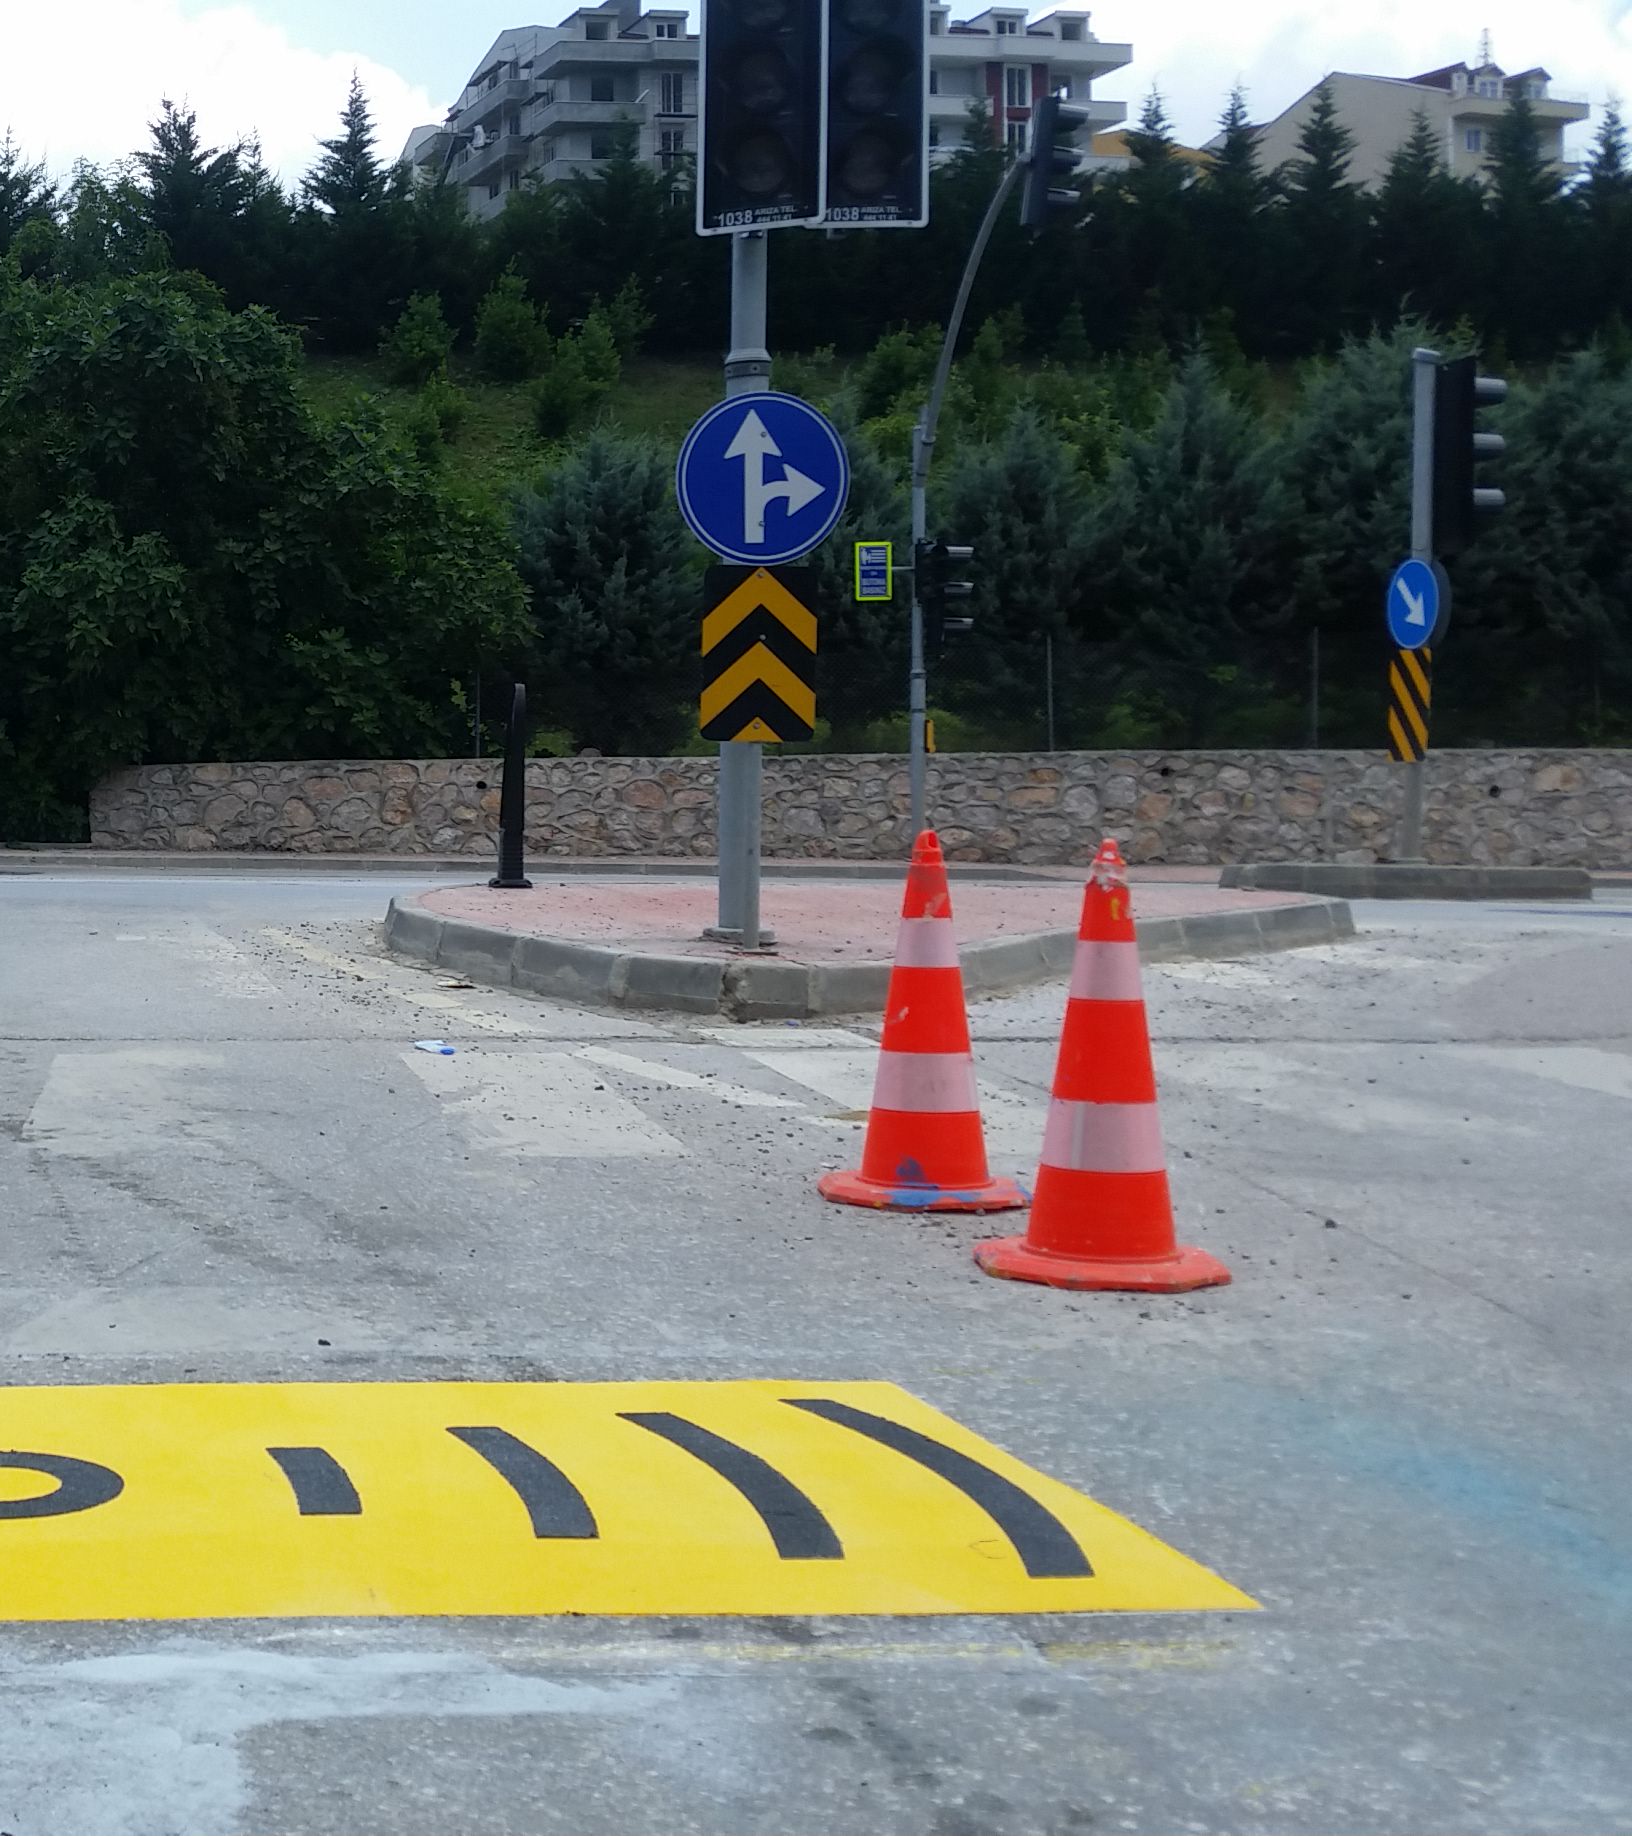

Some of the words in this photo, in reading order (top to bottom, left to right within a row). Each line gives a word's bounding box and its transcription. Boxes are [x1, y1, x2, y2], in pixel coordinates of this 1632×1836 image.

[718, 209, 754, 227] 1038
[755, 207, 779, 216] ARIZA
[826, 207, 859, 221] 1038
